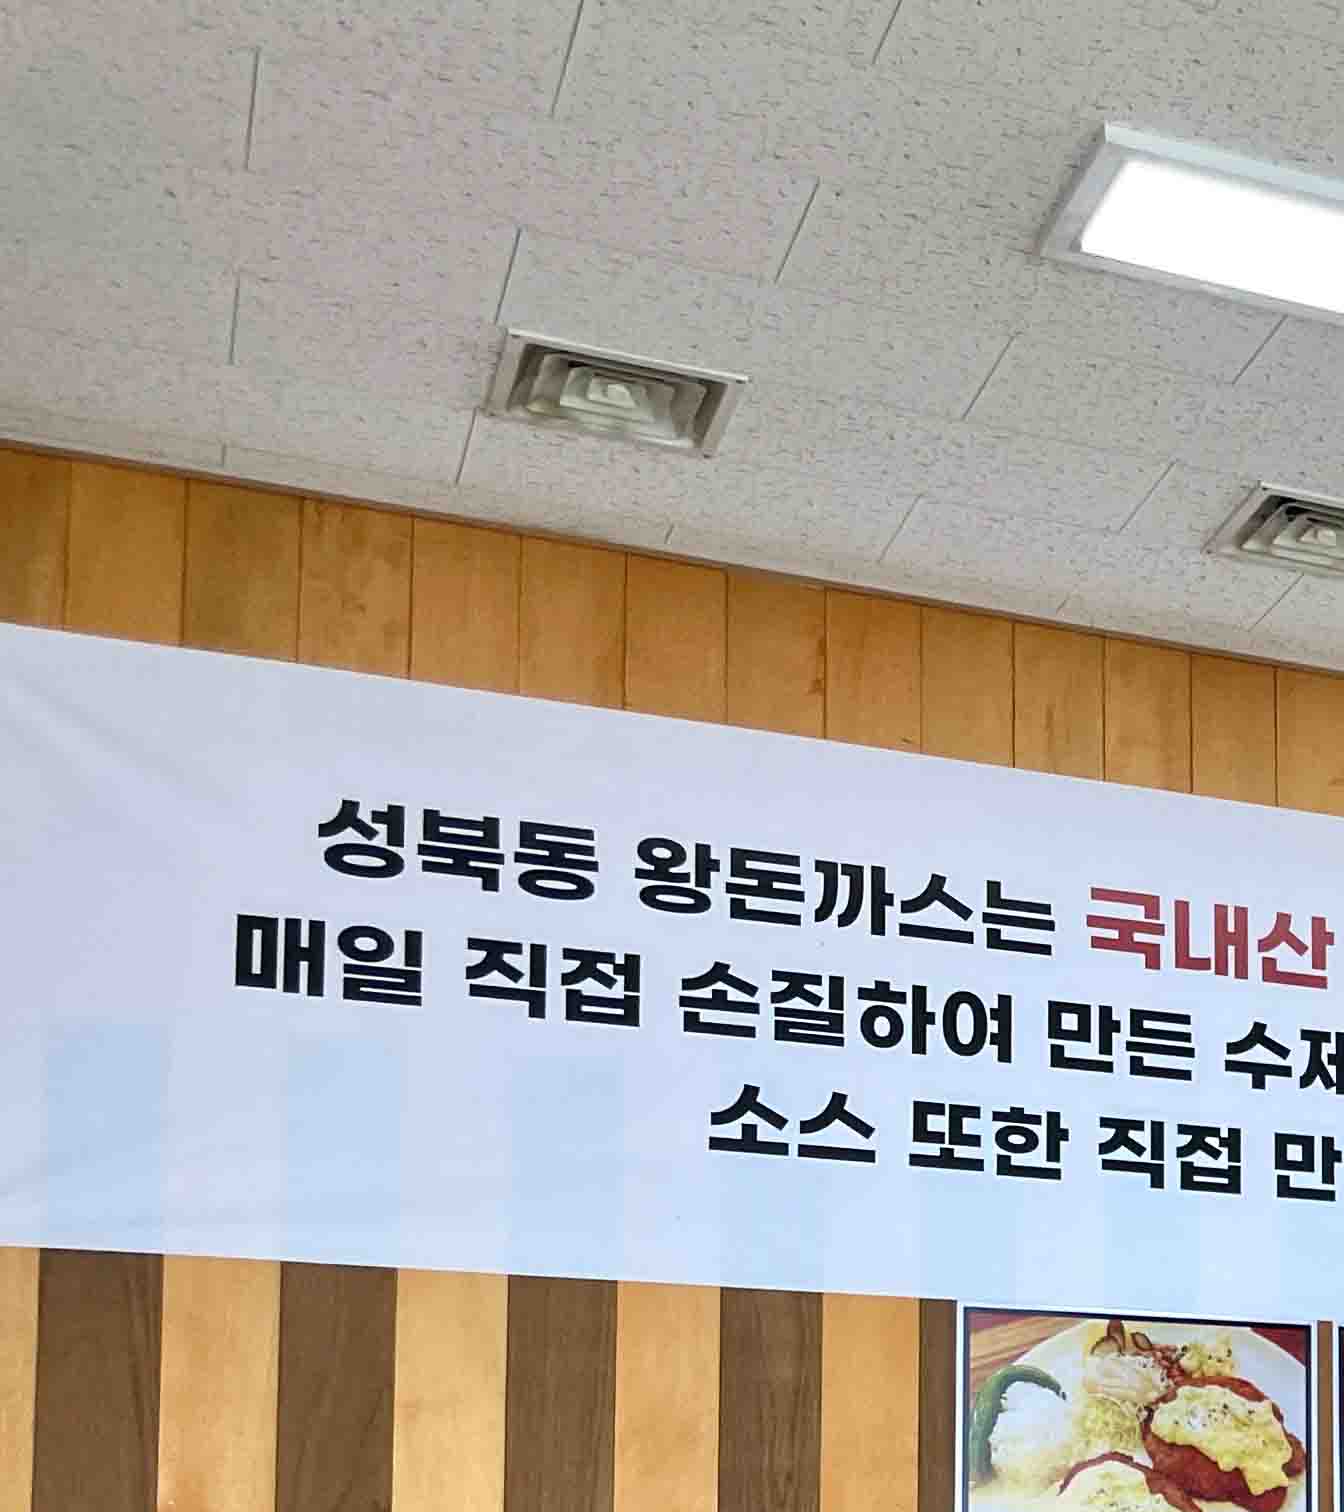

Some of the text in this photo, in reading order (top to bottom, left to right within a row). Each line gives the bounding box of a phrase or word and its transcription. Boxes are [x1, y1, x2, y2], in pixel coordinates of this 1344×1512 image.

[318, 799, 599, 900] 성북동
[635, 838, 1055, 956] 왕돈까스는
[1087, 888, 1334, 989] 국내산
[235, 914, 422, 1006] 매일
[465, 937, 640, 1027] 직접
[679, 961, 1012, 1063] 손질하여
[1048, 1000, 1195, 1081] 만든
[709, 1084, 876, 1163] 소스
[909, 1101, 1069, 1180] 또한
[1098, 1117, 1241, 1194] 직접
